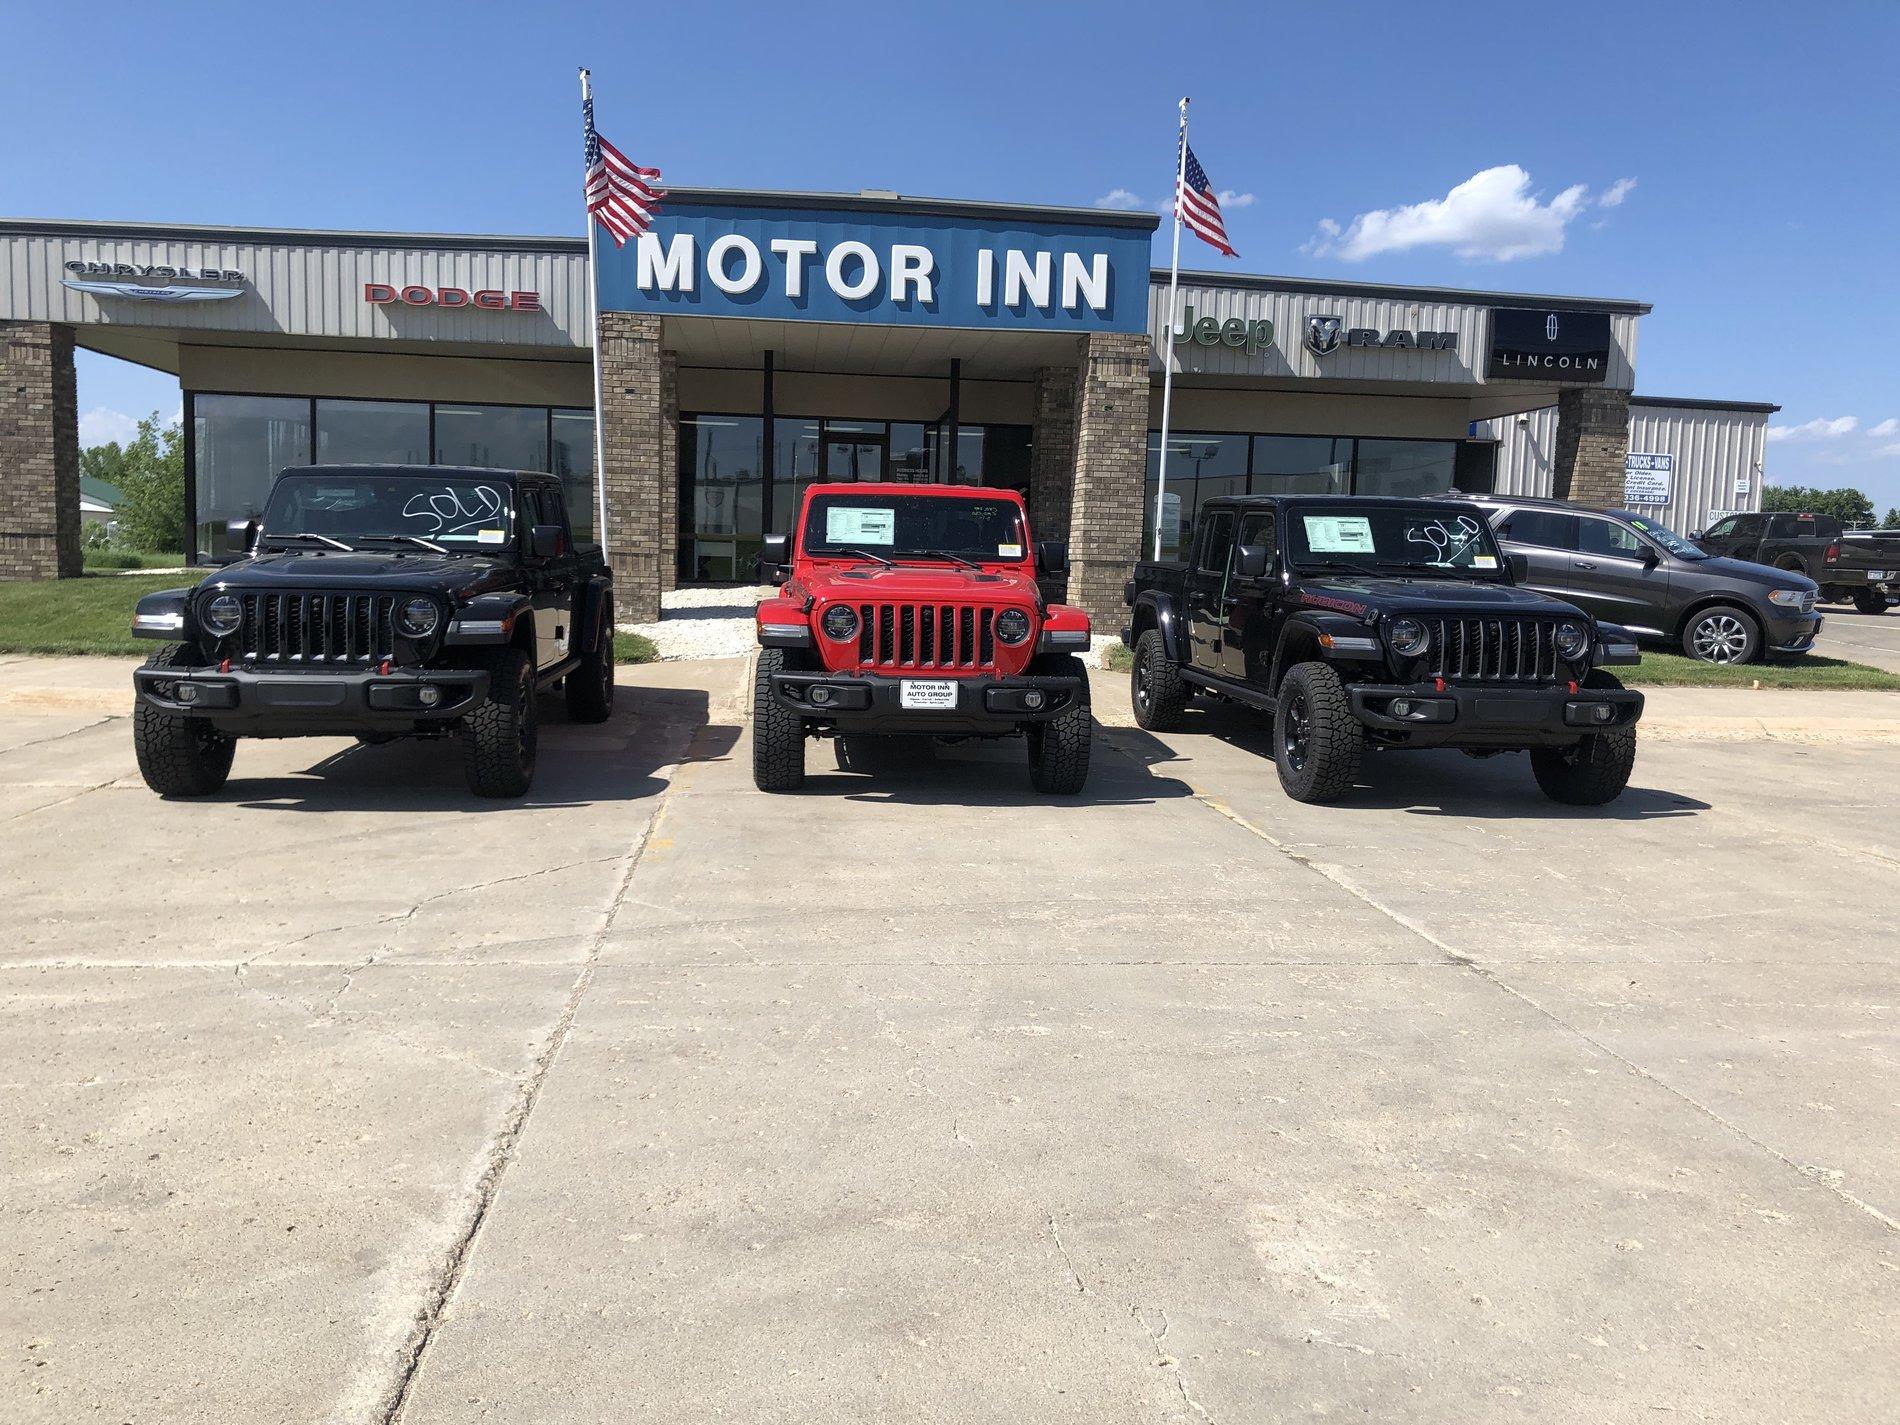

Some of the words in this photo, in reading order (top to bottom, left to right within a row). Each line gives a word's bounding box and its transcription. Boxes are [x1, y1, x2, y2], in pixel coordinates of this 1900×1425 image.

[65, 260, 246, 282] CHRYSLER
[637, 232, 934, 303] MOTOR
[976, 248, 1108, 310] INN
[365, 284, 540, 312] DODGE
[1163, 305, 1275, 355] Jeep
[1348, 328, 1459, 350] RAM
[1502, 353, 1598, 370] LINCOLN
[402, 485, 501, 532] SOLD
[1406, 515, 1479, 562] SOLD
[1301, 593, 1367, 615] RUBICON
